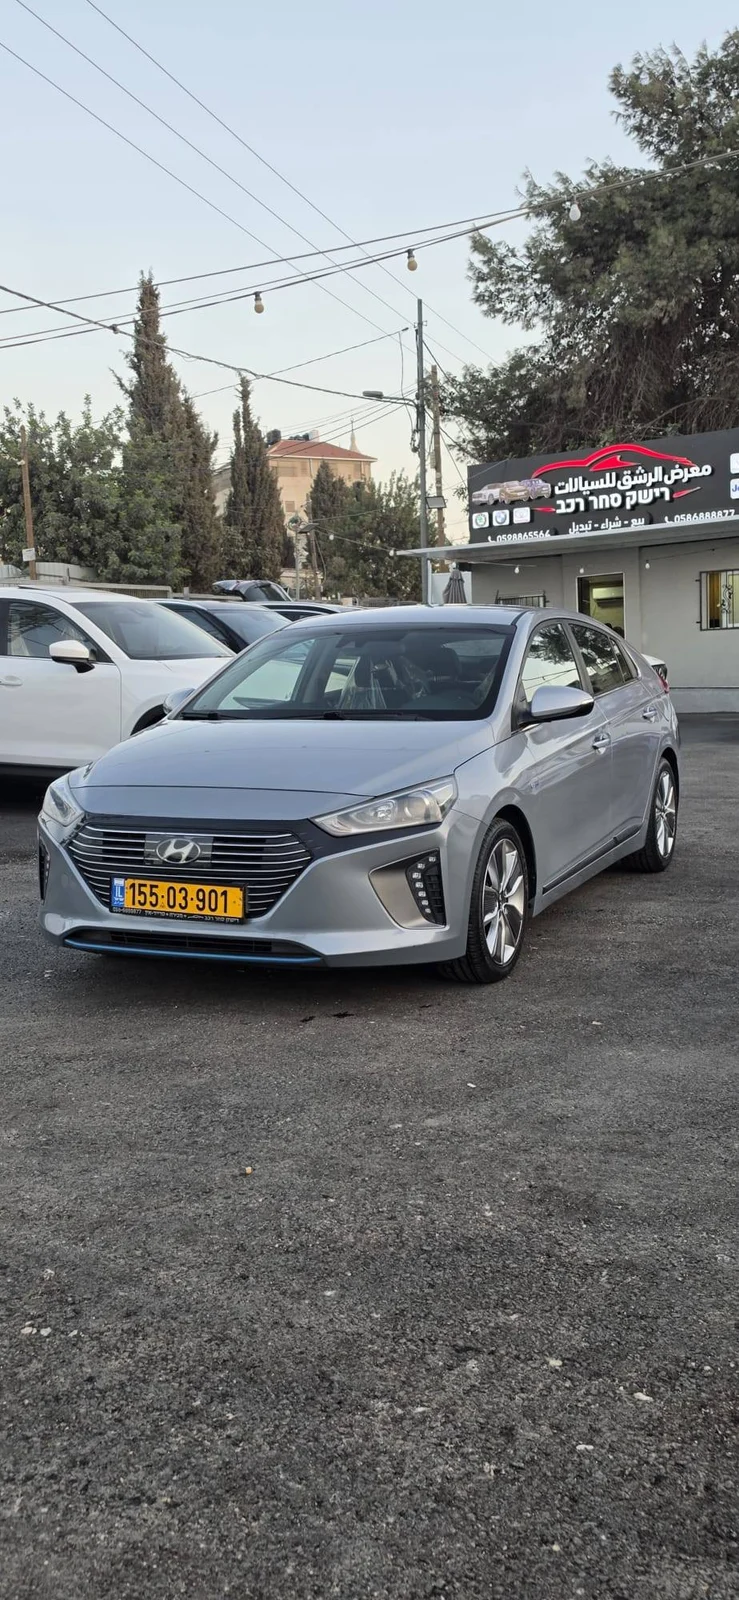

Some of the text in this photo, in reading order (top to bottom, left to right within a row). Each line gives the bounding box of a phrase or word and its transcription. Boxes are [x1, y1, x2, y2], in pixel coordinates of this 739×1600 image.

[617, 466, 663, 490] الرشق
[664, 464, 712, 485] معرض
[555, 487, 670, 514] רישק סחר רכב
[600, 515, 622, 530] شراء
[674, 509, 735, 523] 0586888877
[568, 520, 592, 534] تبديل
[115, 886, 123, 898] IL
